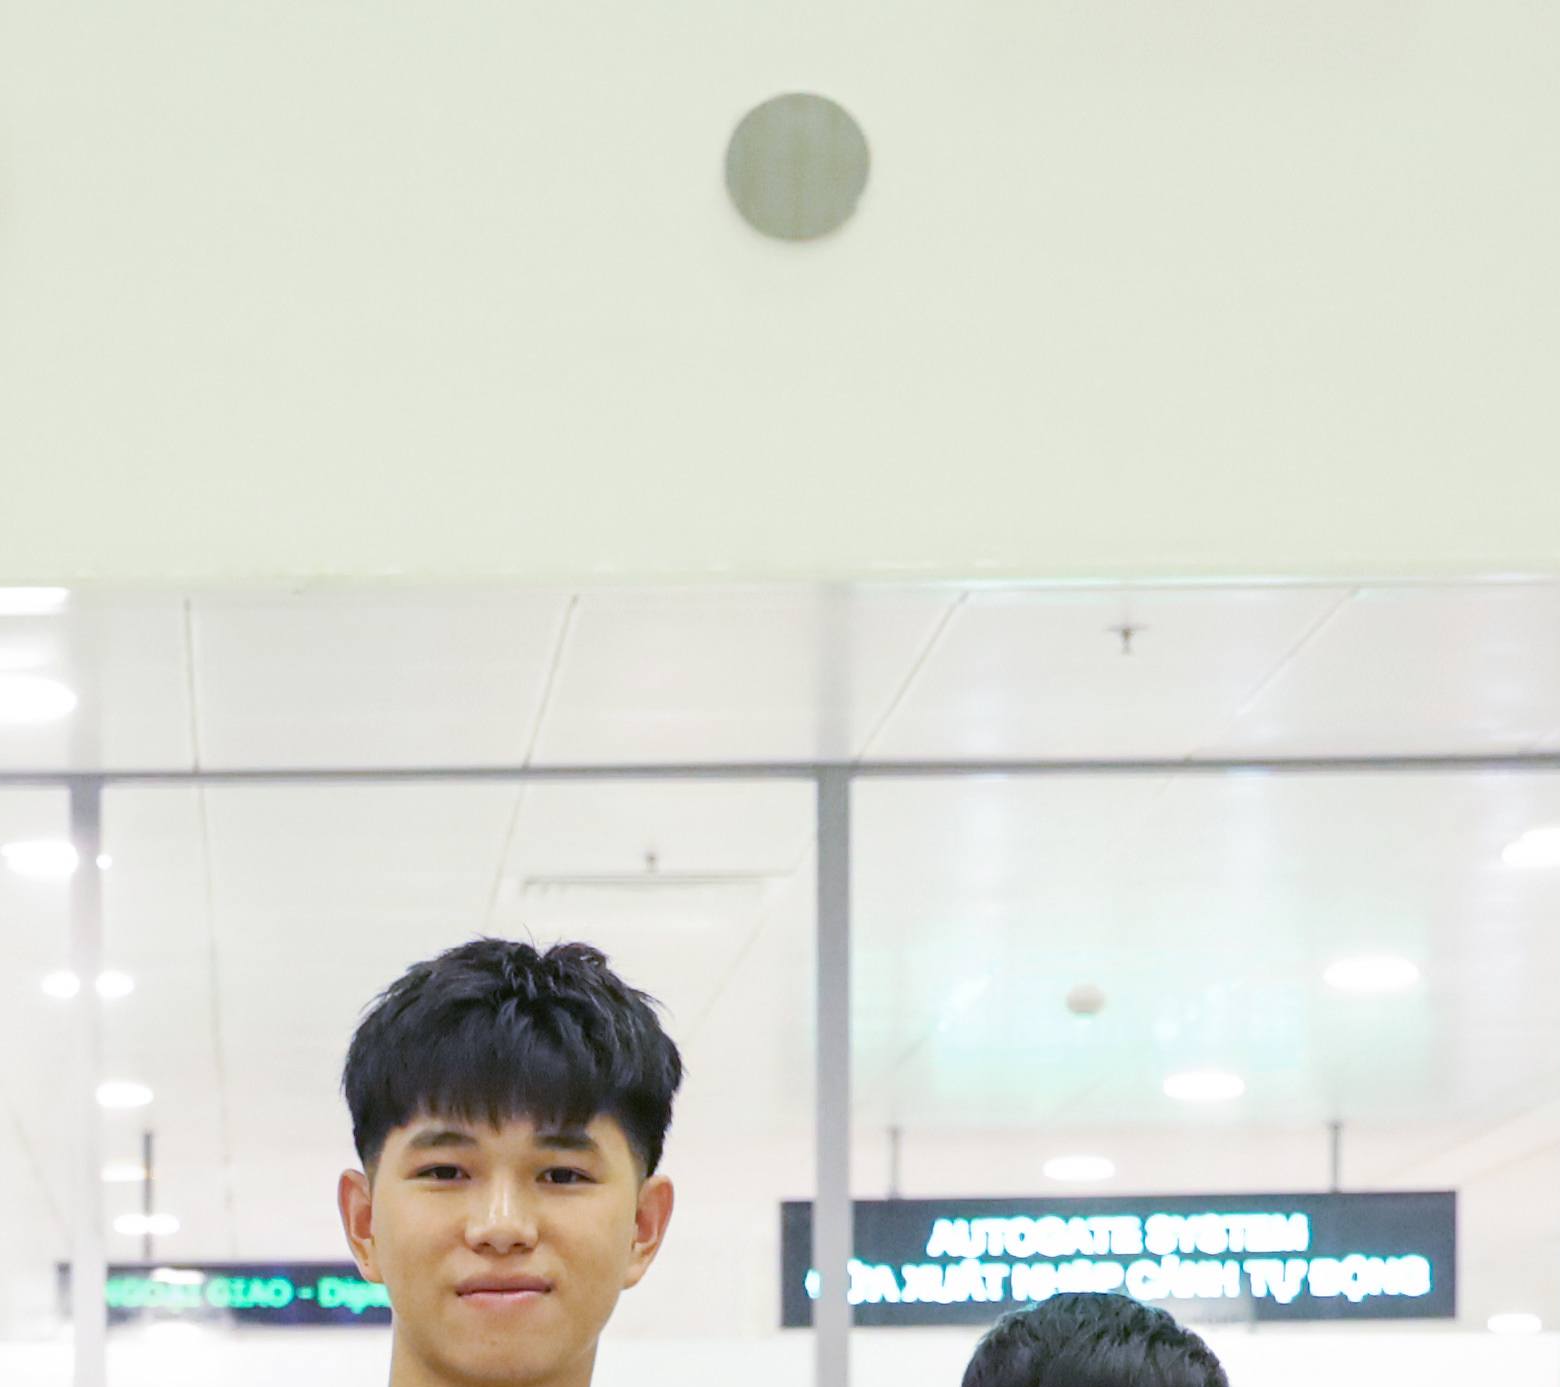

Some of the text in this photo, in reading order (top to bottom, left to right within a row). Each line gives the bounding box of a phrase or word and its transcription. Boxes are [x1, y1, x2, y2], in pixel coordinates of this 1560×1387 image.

[926, 1212, 1309, 1258] AUTOGATE SYSTEM
[206, 1275, 295, 1309] GIAO
